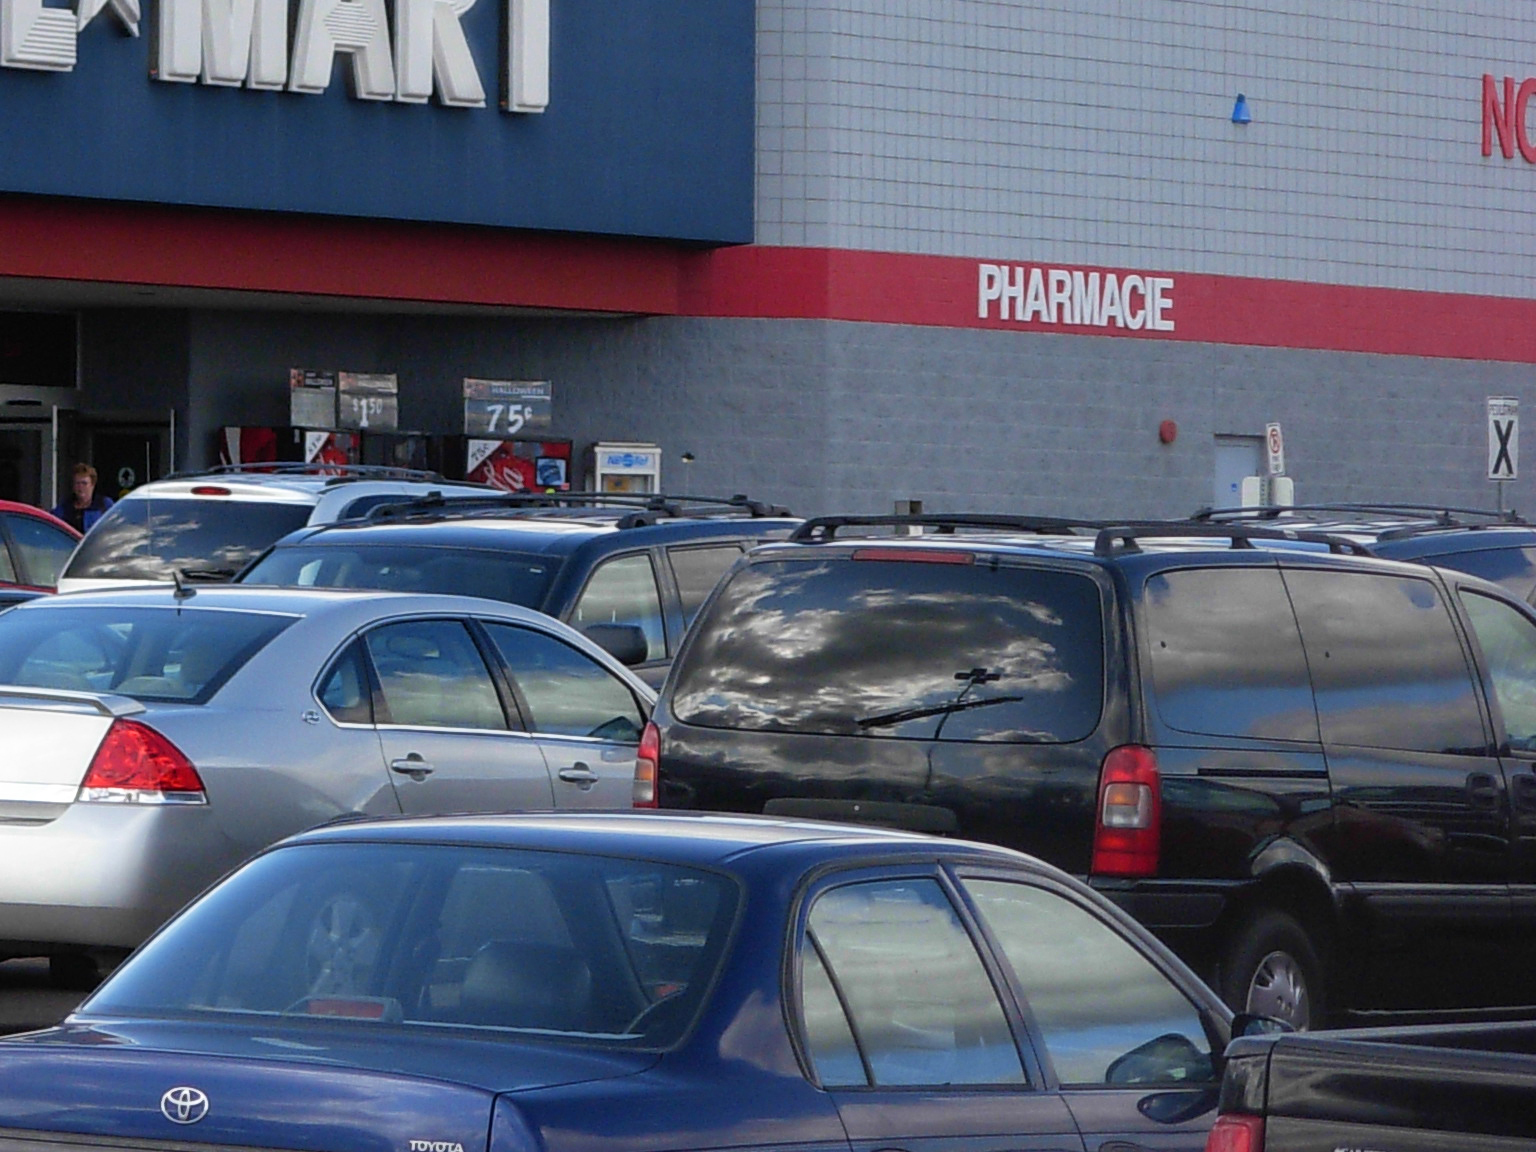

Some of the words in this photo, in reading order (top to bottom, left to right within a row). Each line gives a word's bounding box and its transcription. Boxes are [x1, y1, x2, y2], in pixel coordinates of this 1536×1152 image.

[978, 263, 1175, 332] PHARMACIE
[1492, 419, 1514, 475] X
[409, 1139, 464, 1152] TOYOTA
